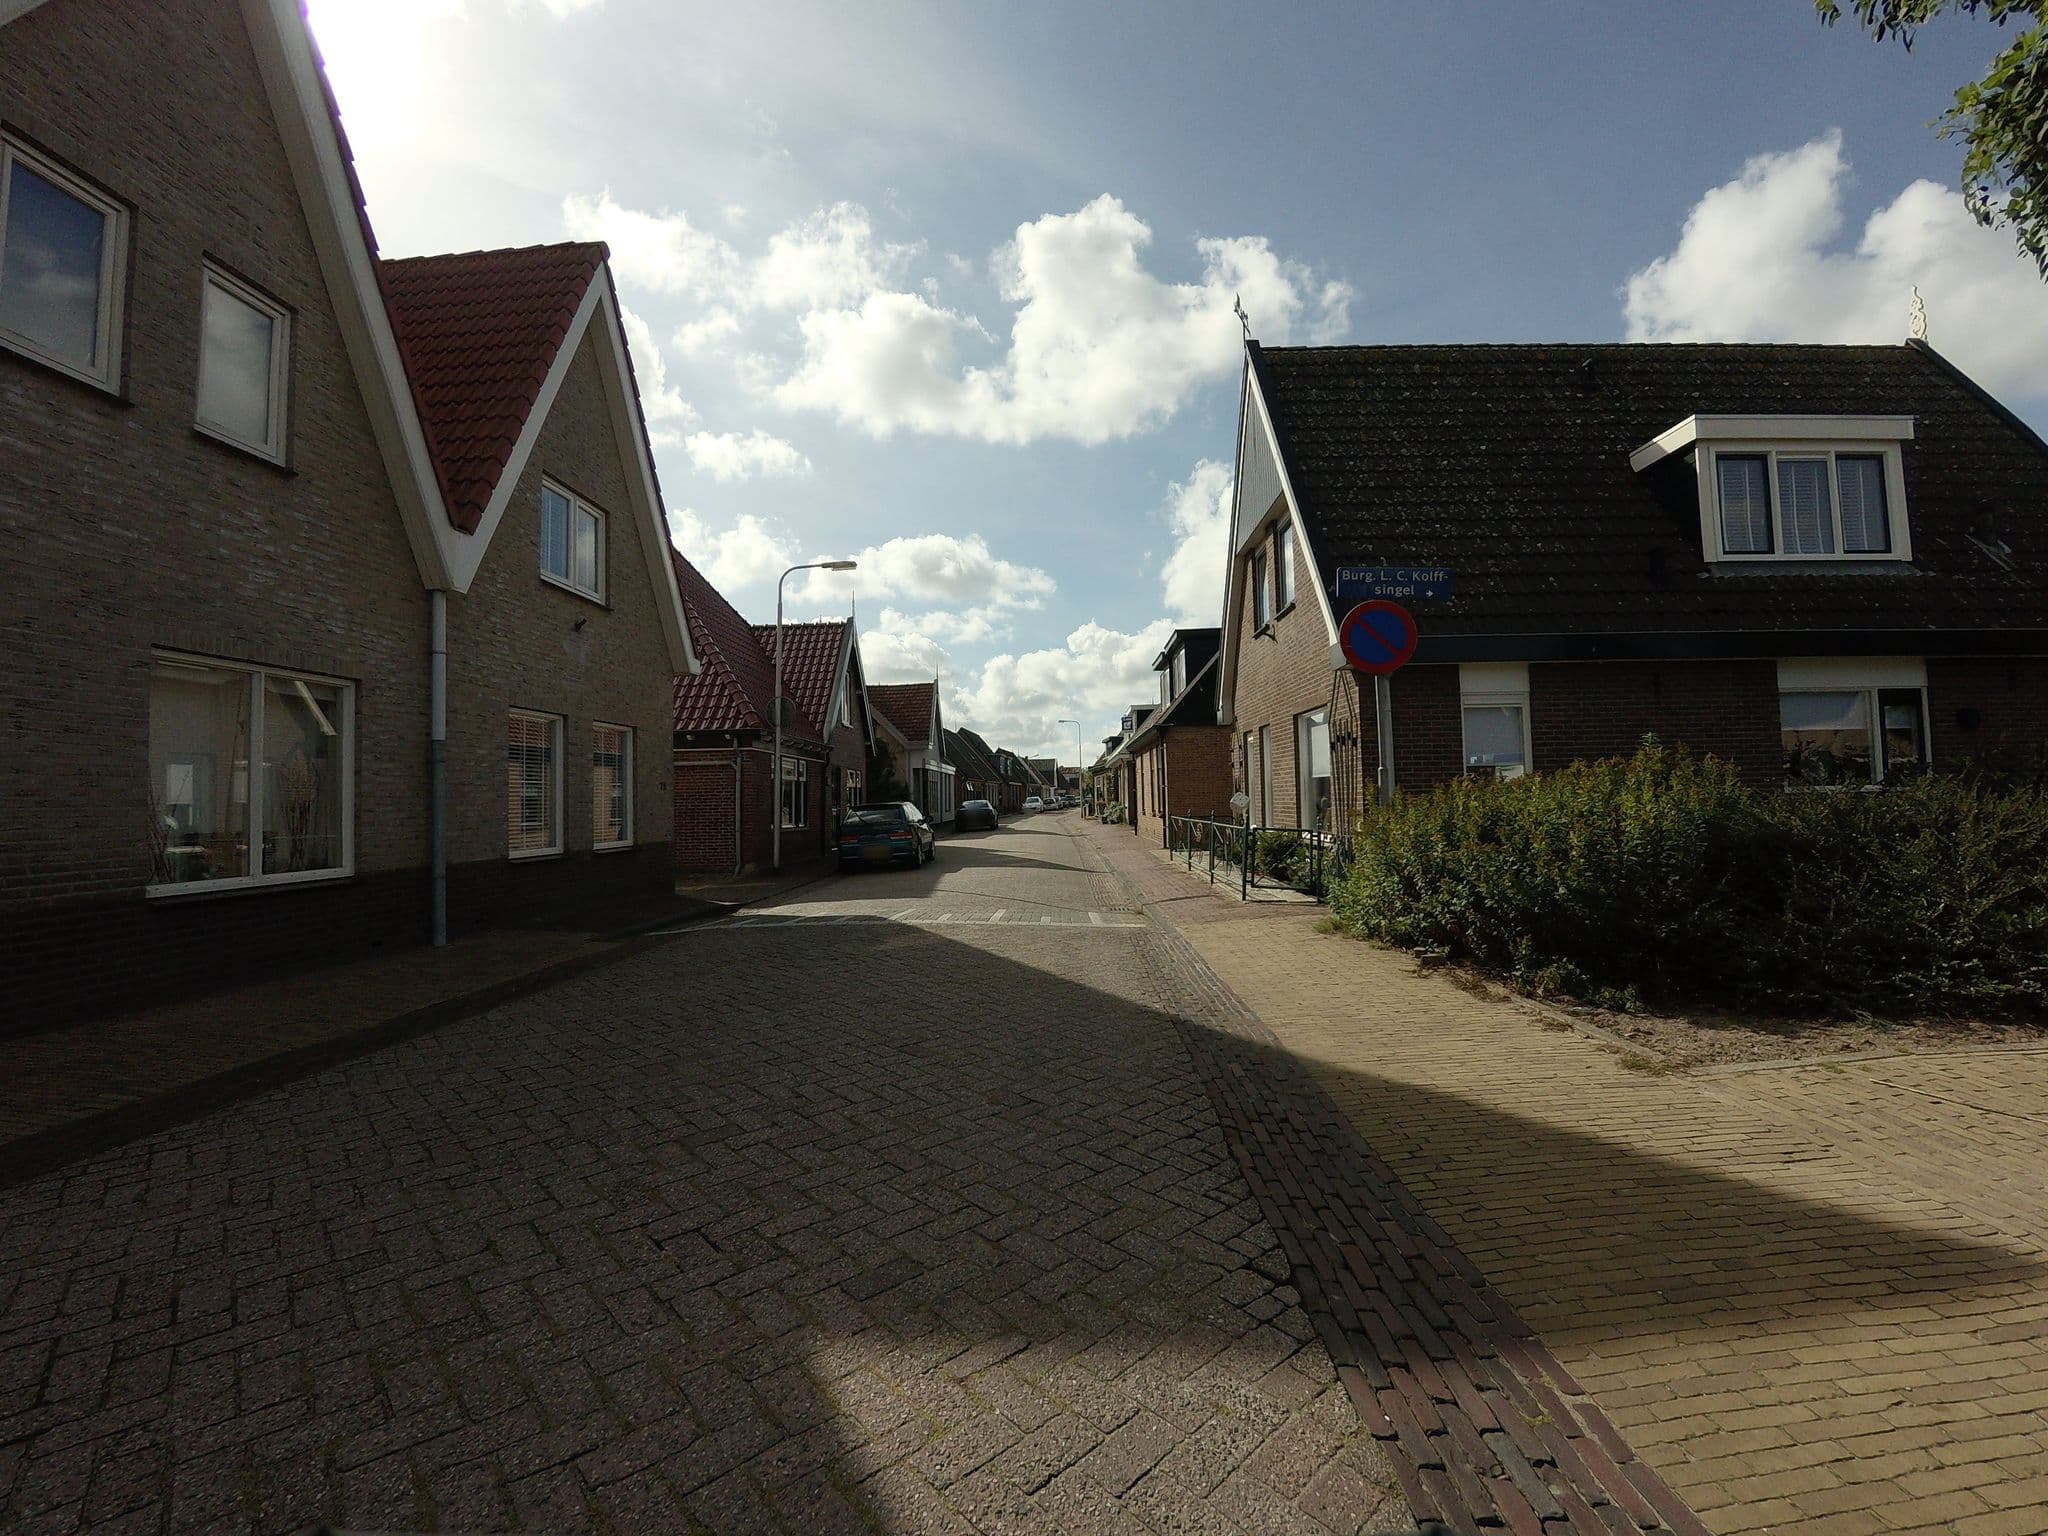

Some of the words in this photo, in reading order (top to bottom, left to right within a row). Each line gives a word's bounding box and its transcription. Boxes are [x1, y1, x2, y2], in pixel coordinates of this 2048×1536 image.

[1342, 570, 1377, 583] Burg.
[1380, 570, 1392, 581] L.
[1396, 570, 1408, 581] C.
[1412, 570, 1449, 582] Kolff-
[1374, 584, 1415, 597] singel
